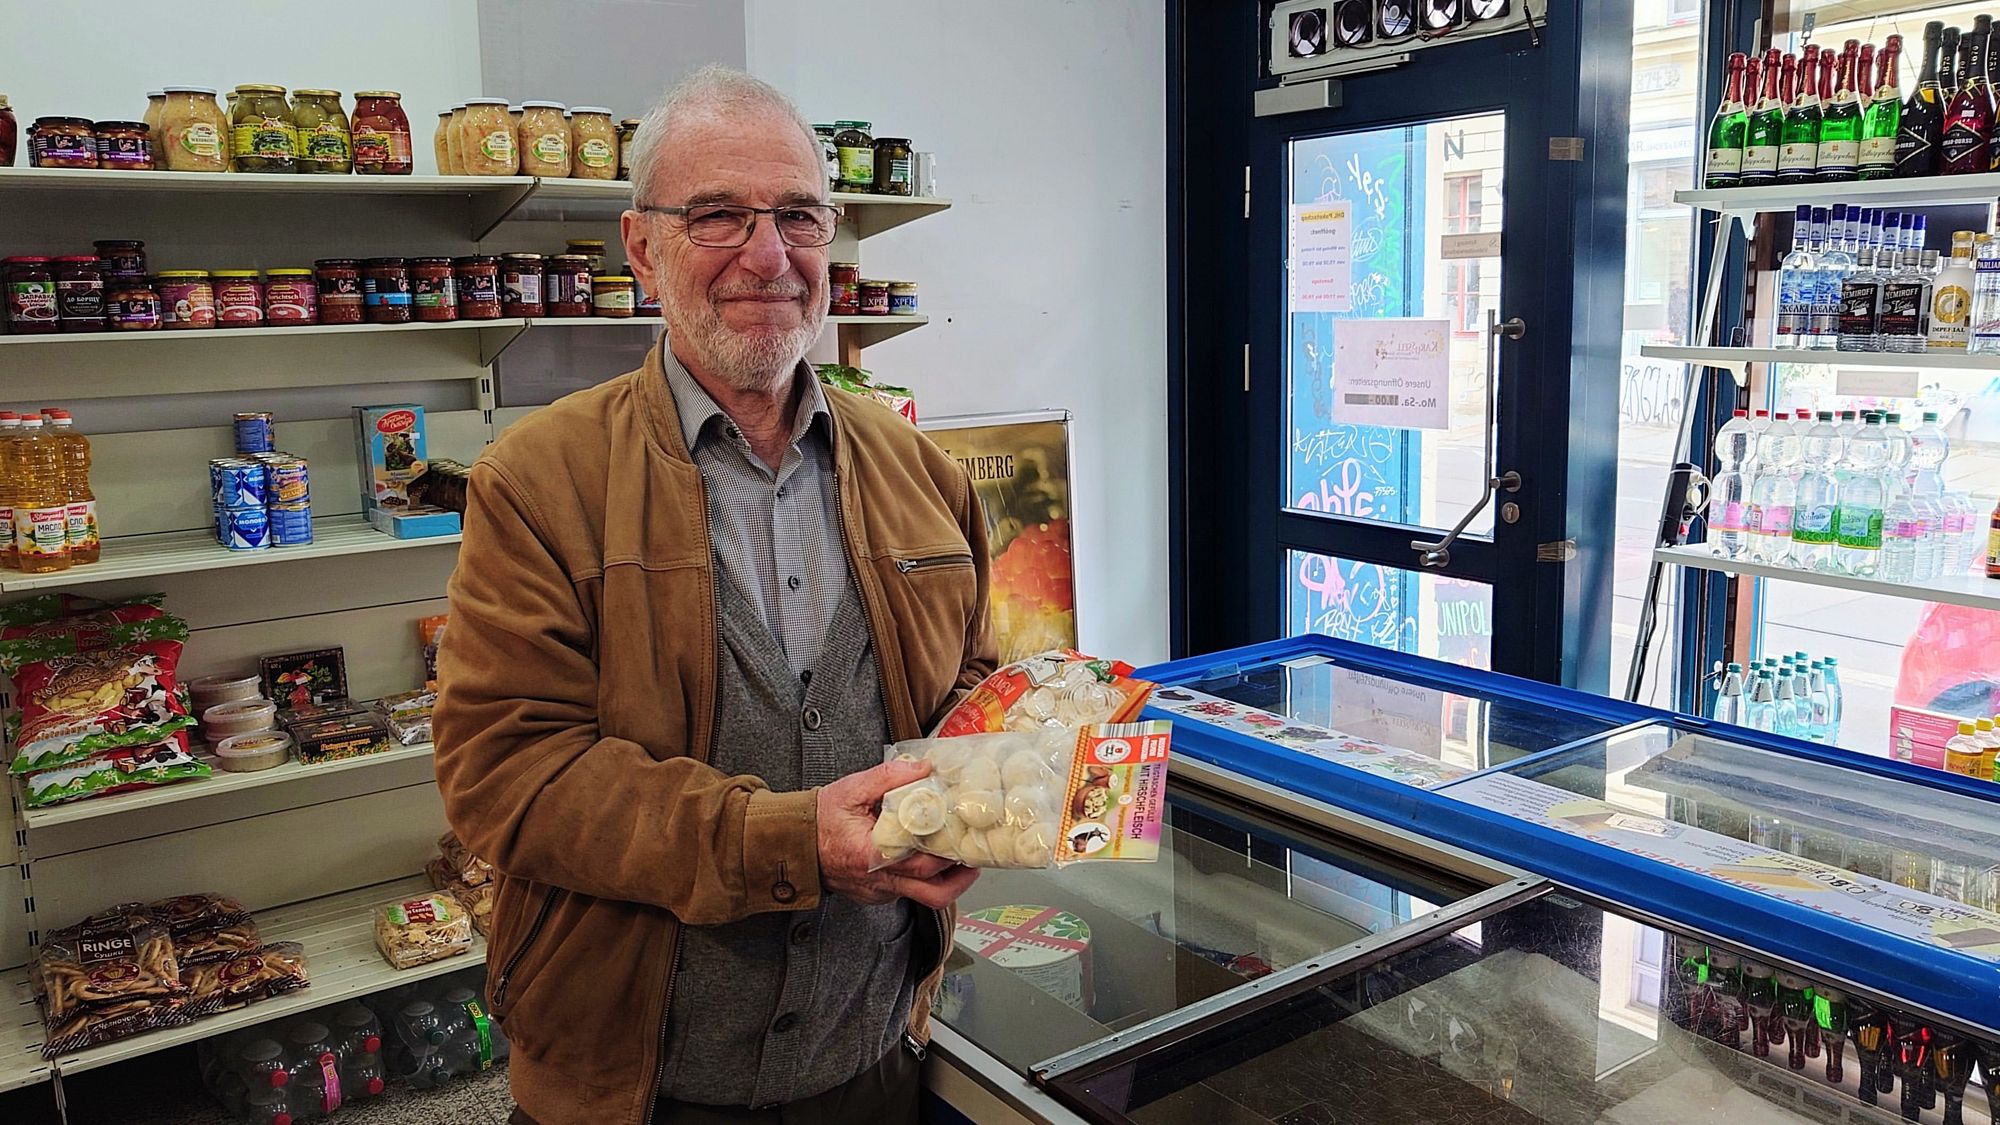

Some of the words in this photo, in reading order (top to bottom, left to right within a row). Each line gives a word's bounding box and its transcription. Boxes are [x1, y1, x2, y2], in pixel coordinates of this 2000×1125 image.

[1841, 286, 1875, 300] NEMIROFF
[1885, 286, 1919, 301] NEMIROFF
[868, 298, 889, 306] ХРЕН
[894, 298, 914, 306] ХРЕН
[1779, 304, 1809, 314] ЖЕЛКА
[1932, 326, 1966, 334] IMPERIAL
[956, 454, 1015, 481] EMBERG
[38, 523, 62, 533] МАСЛО
[1139, 764, 1150, 777] MIT
[1149, 763, 1161, 799] TEIGTASCHEN
[1130, 778, 1149, 840] HIRSCHFLEISCH
[1147, 799, 1157, 823] GEFÜLLT
[82, 938, 132, 953] RINGE
[94, 949, 124, 959] Сушки
